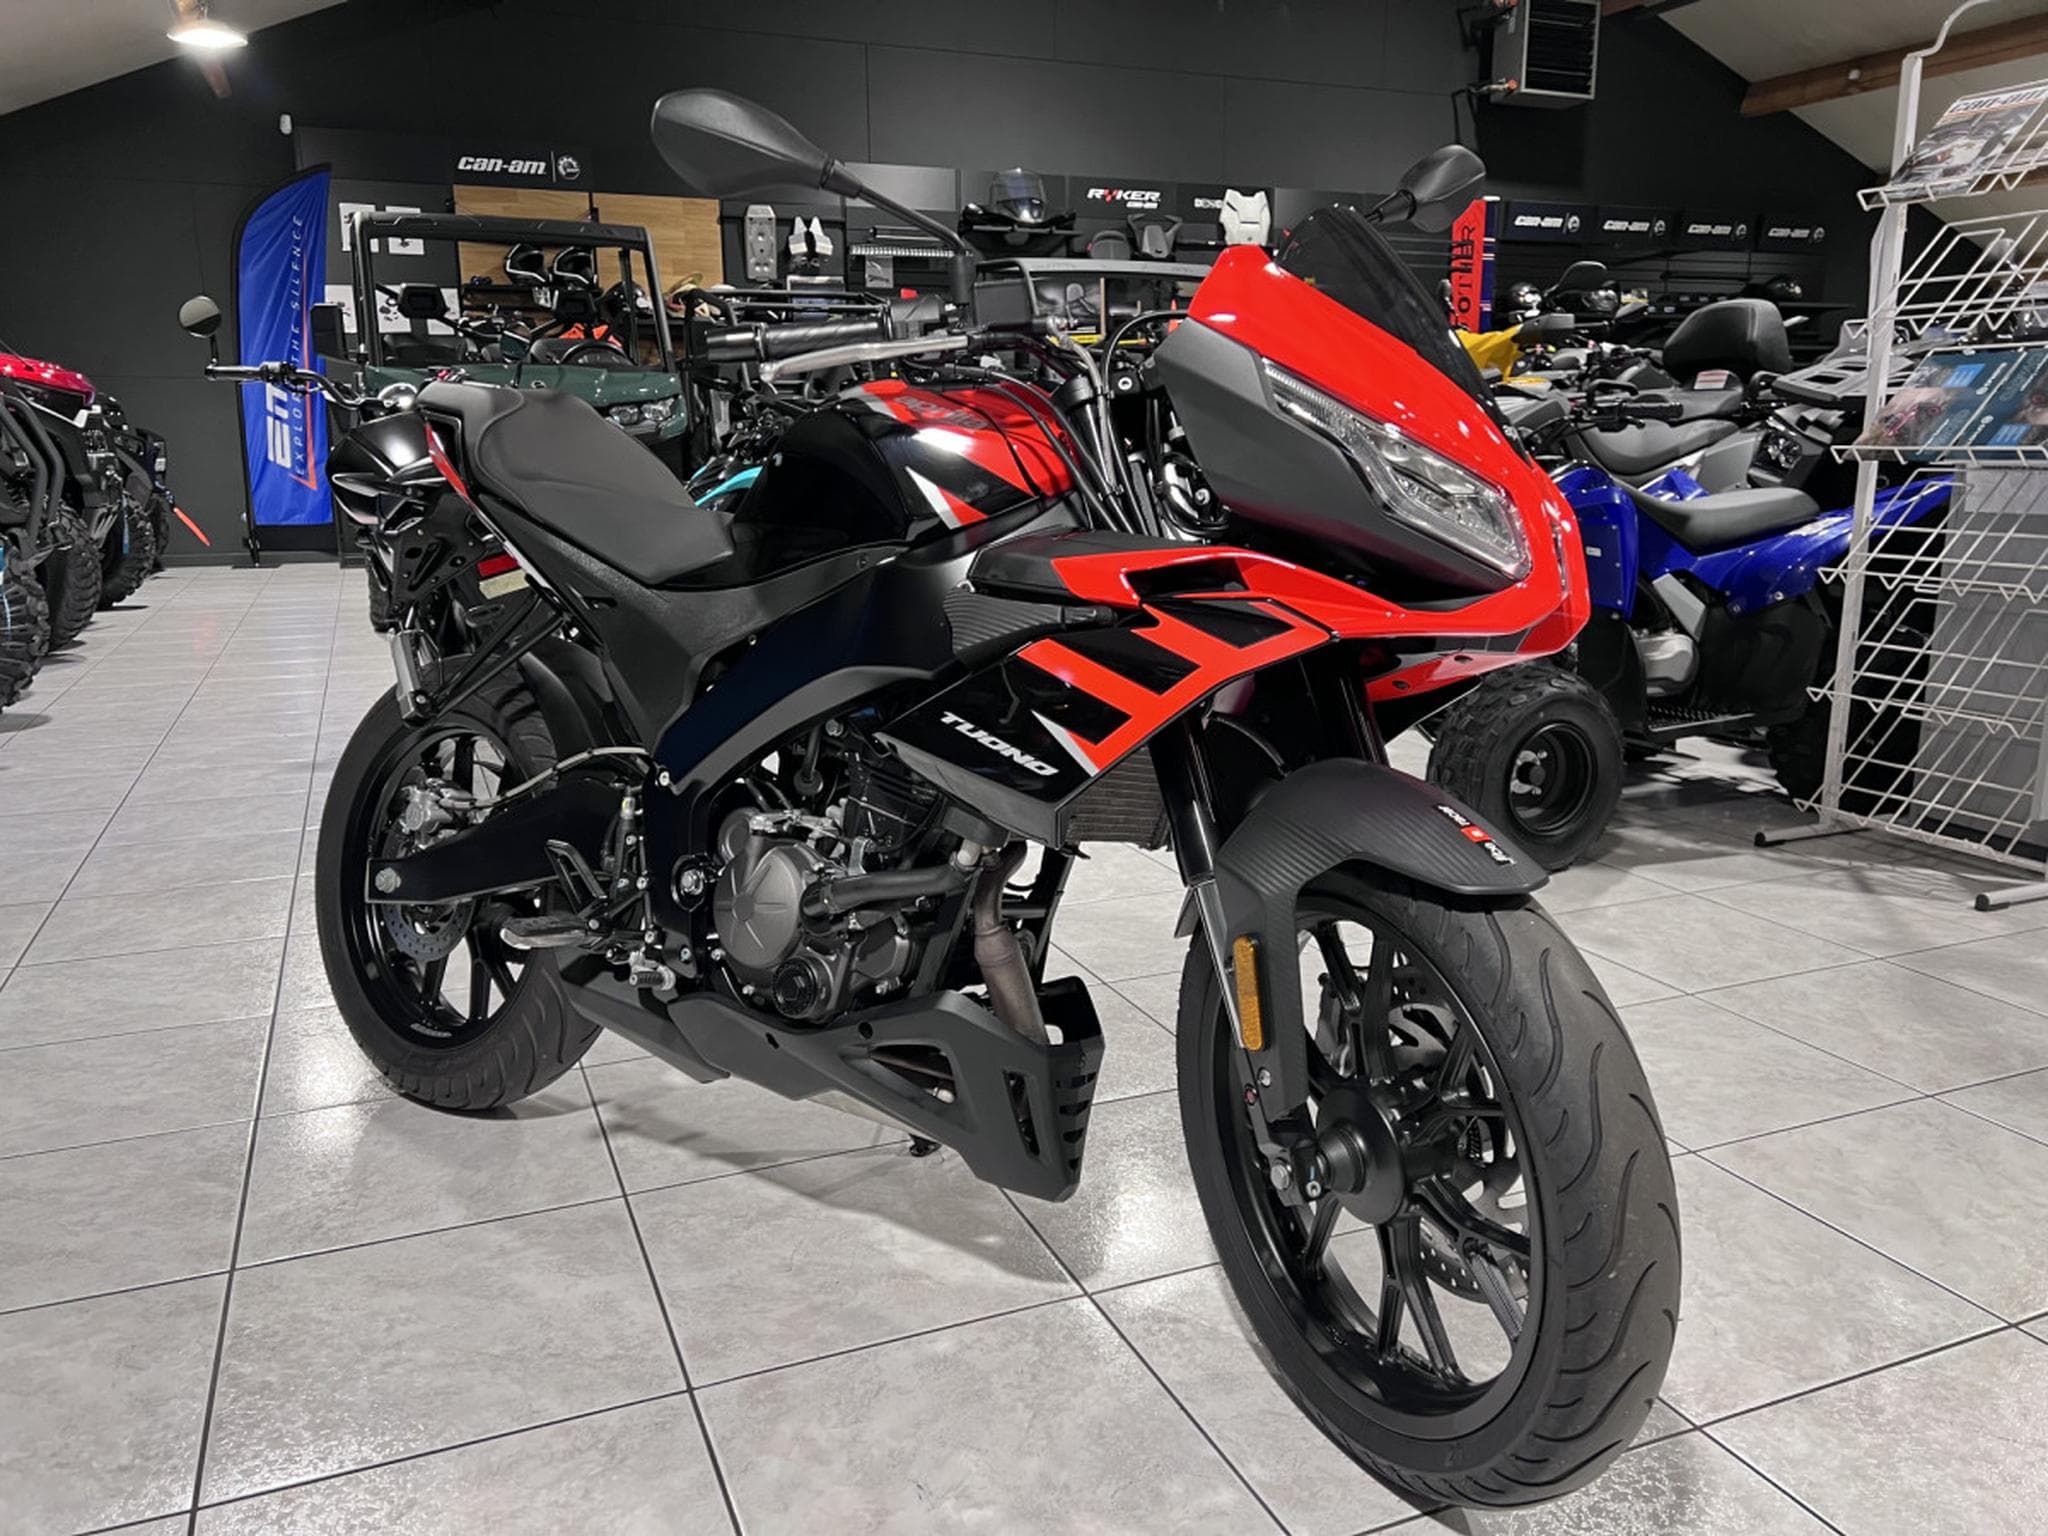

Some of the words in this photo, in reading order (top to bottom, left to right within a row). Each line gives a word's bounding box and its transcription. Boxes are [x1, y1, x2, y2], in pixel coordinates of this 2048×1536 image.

[458, 156, 546, 175] can-am
[291, 215, 303, 311] SILENCE
[940, 711, 1060, 776] TUONO
